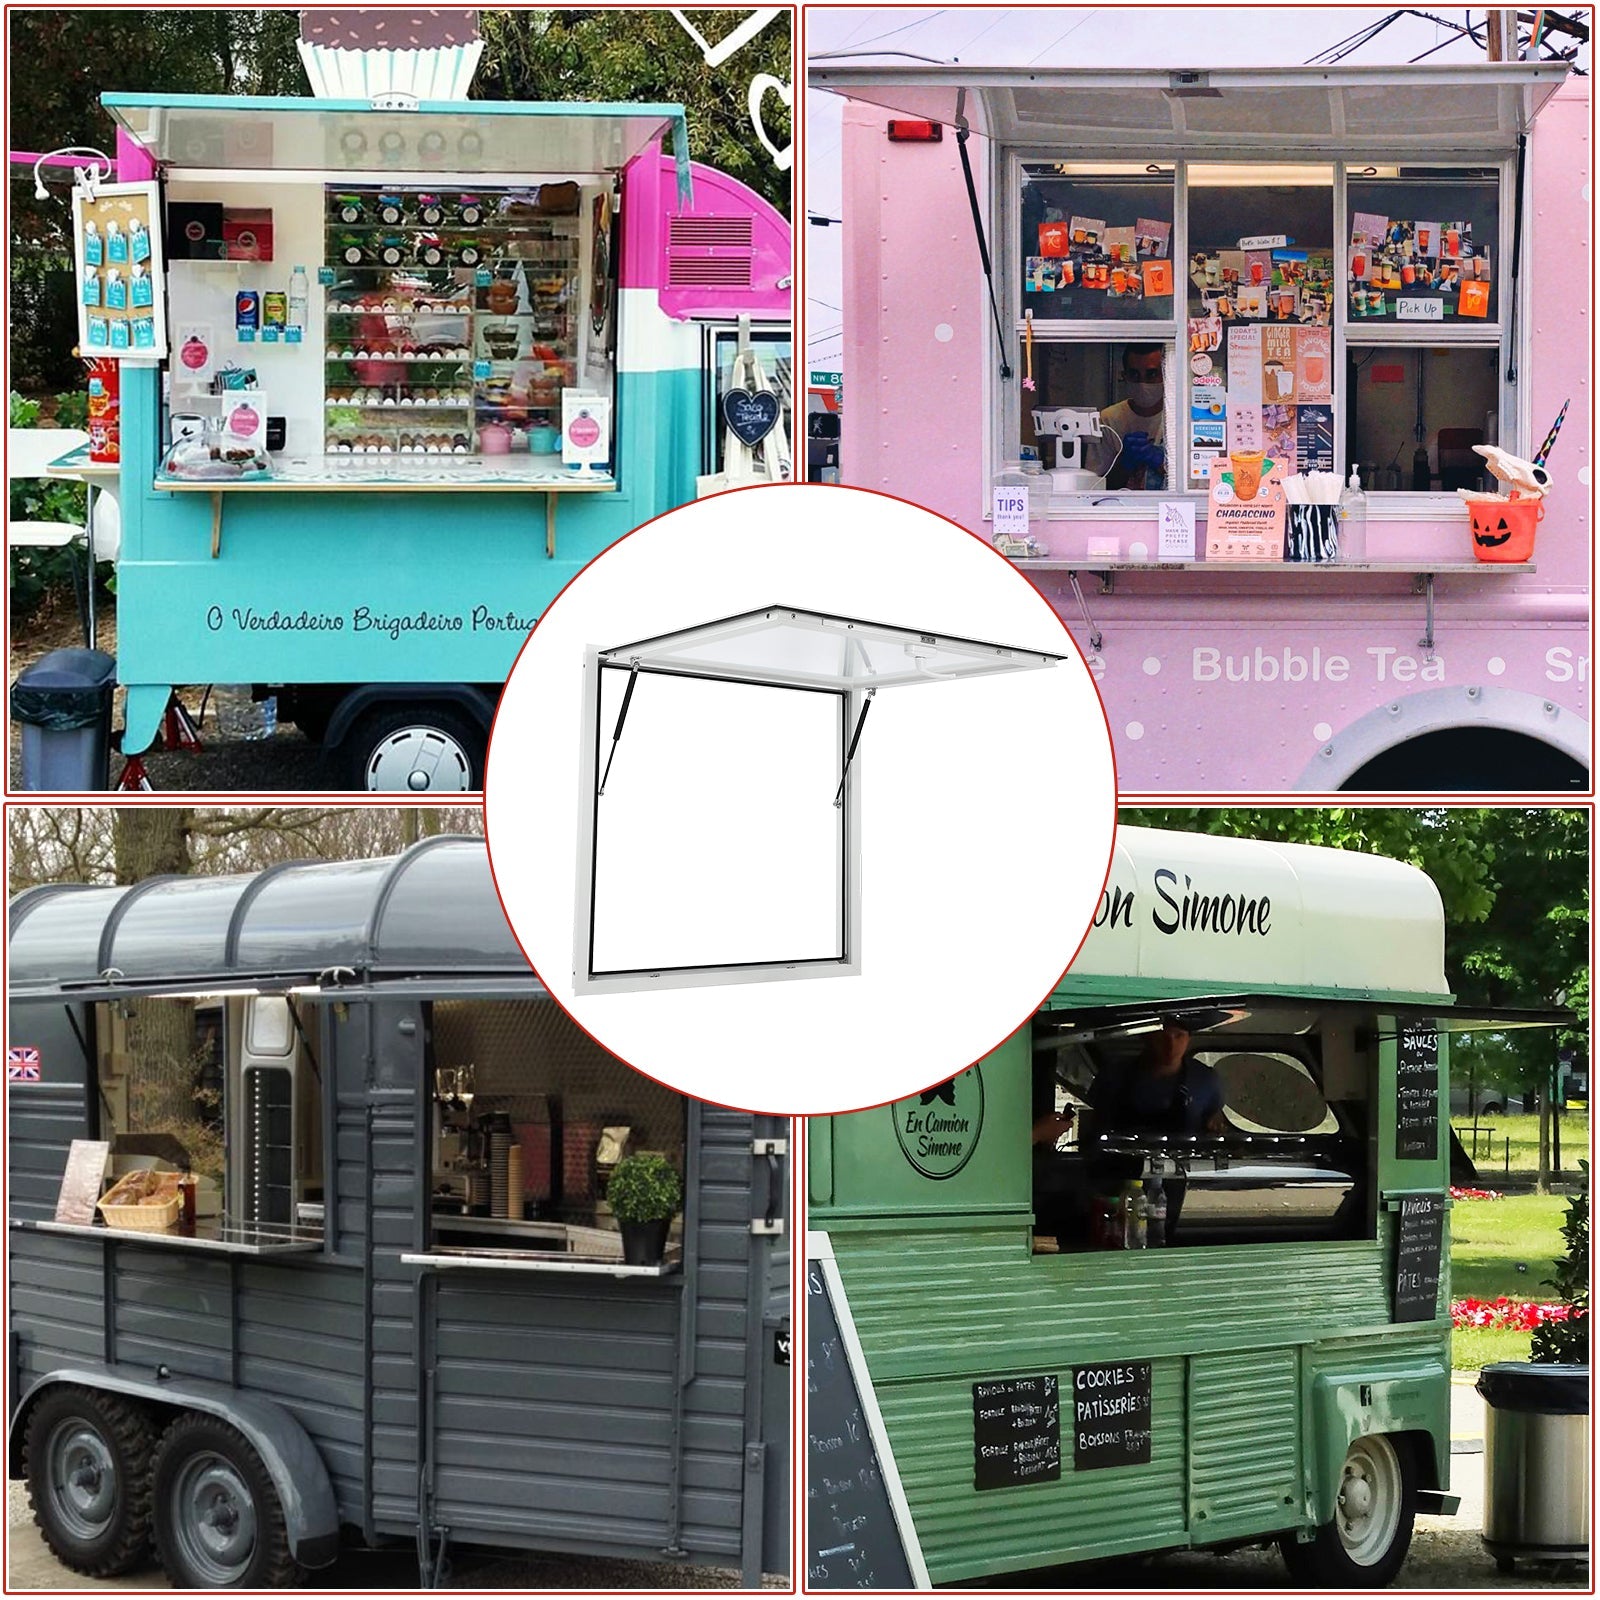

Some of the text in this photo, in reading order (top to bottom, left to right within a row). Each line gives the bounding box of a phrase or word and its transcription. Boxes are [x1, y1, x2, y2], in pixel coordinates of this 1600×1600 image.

[1399, 300, 1438, 318] Pick Up
[1230, 327, 1258, 335] TODAY'S
[1266, 326, 1291, 339] GINGER
[1267, 338, 1291, 348] MILK
[1267, 347, 1291, 357] TEA
[997, 498, 1025, 512] TIPS
[1215, 509, 1275, 519] CHAGACCINO
[206, 605, 222, 632] O
[232, 607, 345, 632] Verdadeiro
[352, 606, 463, 640] Brigadeiro
[1192, 646, 1351, 682] Bubble
[1365, 646, 1445, 682] Tea
[1152, 867, 1272, 937] Simone
[905, 1110, 969, 1134] En Camion
[916, 1134, 962, 1158] Simone
[1076, 1366, 1135, 1390] COOKIES
[1077, 1391, 1142, 1422] PATISSERIES
[1079, 1430, 1121, 1451] BOISSONS
